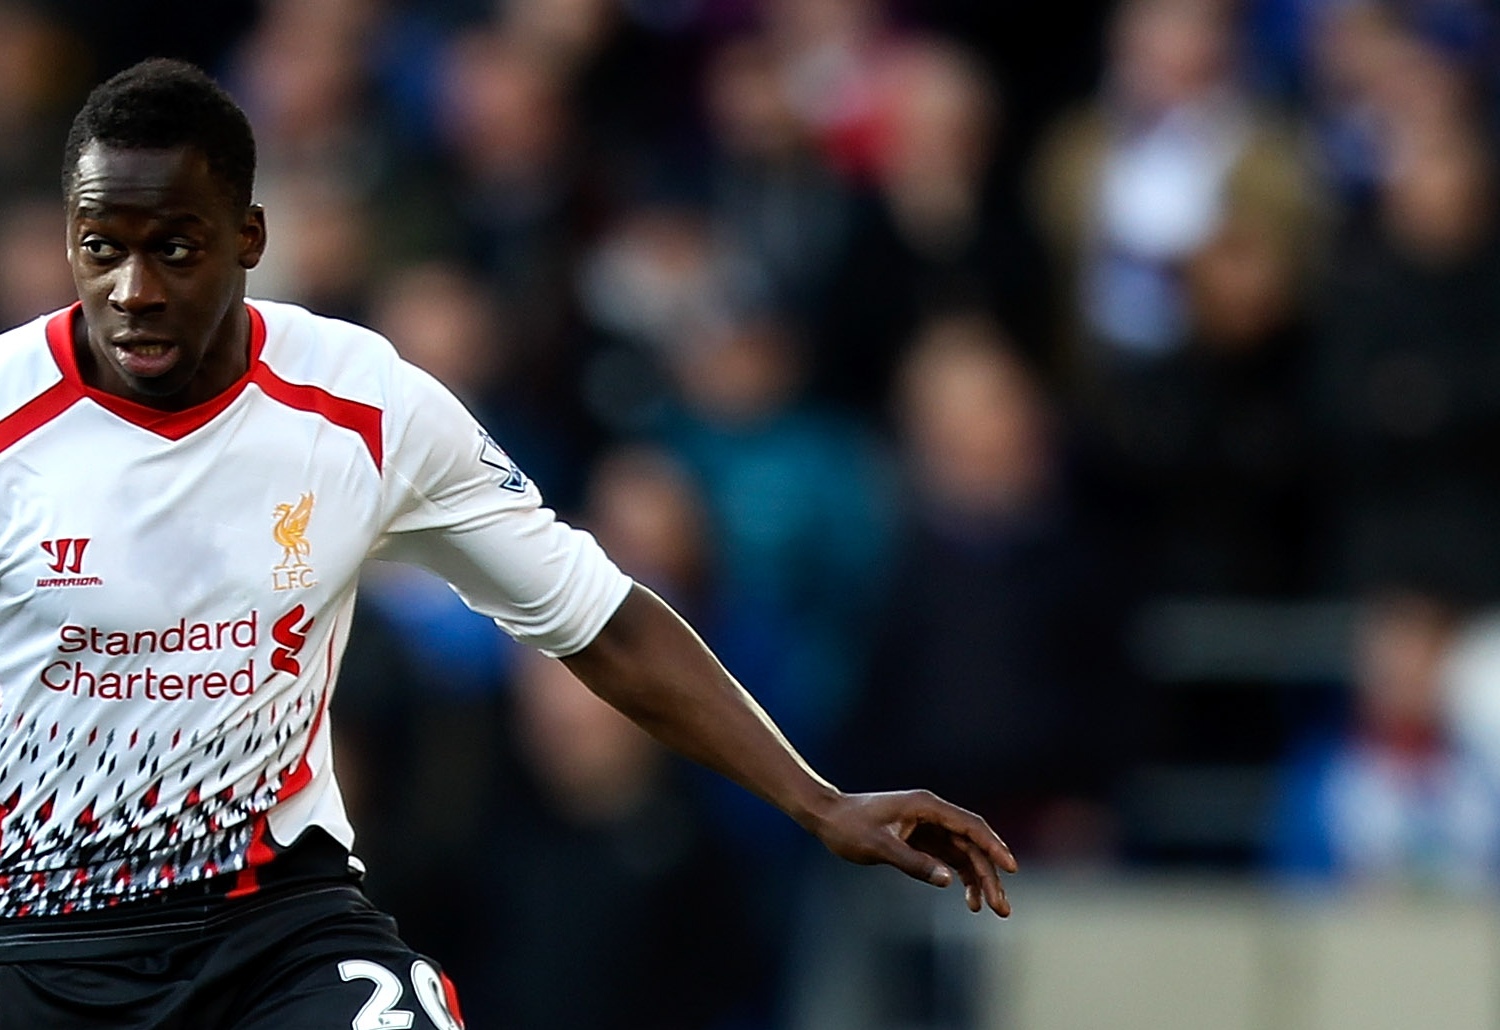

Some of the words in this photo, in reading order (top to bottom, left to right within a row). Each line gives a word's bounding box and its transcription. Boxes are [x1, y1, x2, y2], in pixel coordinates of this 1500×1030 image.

[36, 576, 99, 588] WARRIOR
[57, 610, 258, 656] Standard
[40, 658, 254, 701] Chartered
